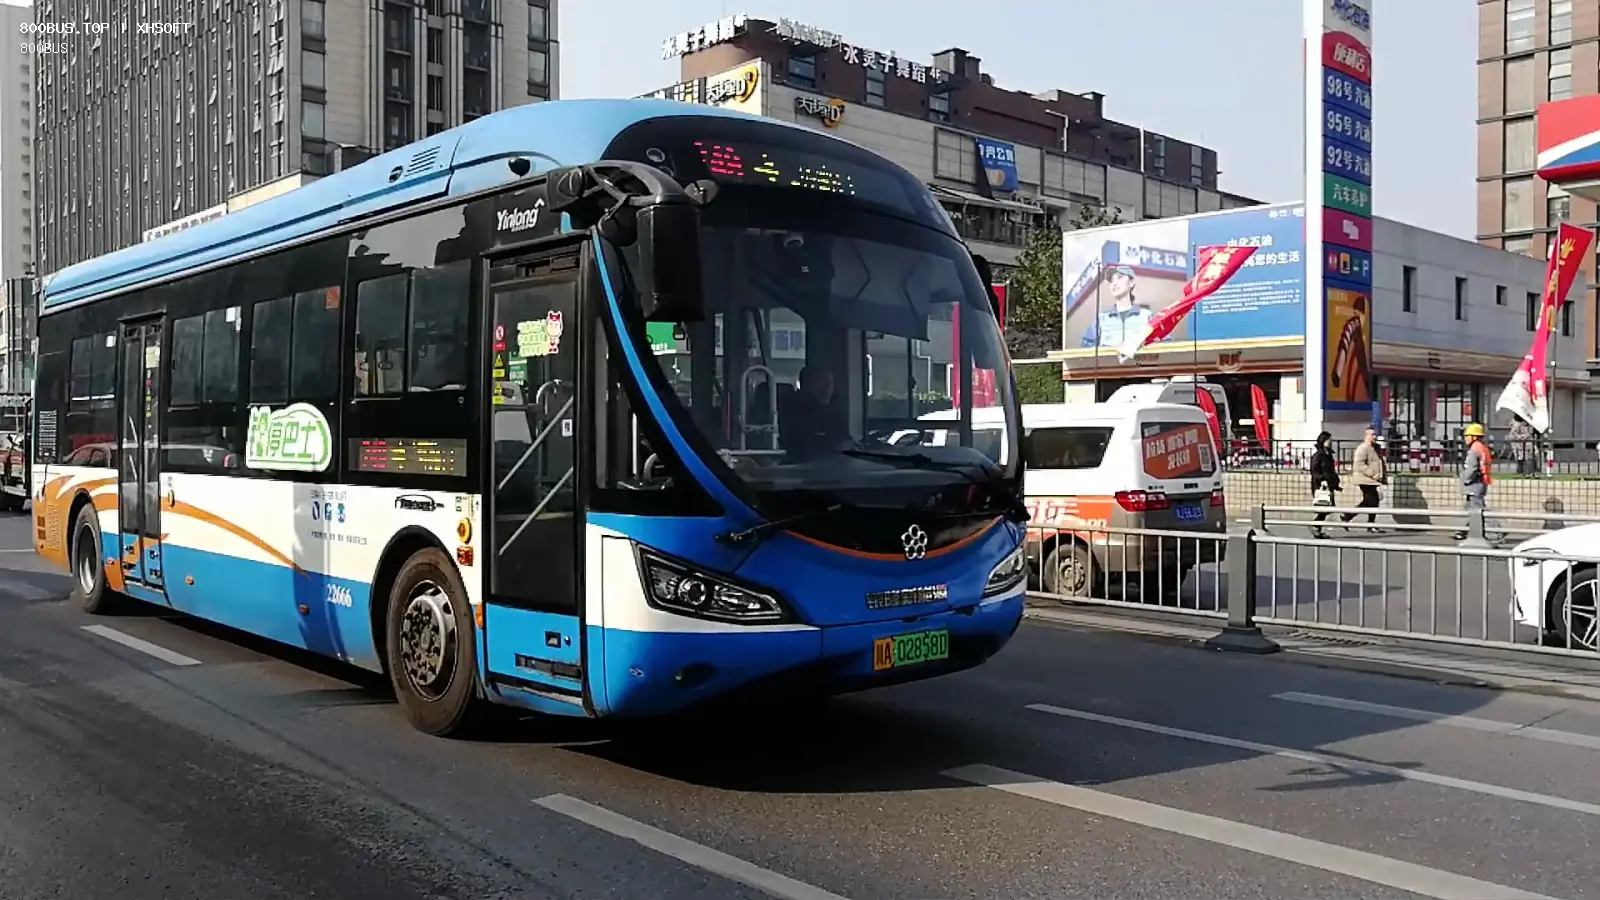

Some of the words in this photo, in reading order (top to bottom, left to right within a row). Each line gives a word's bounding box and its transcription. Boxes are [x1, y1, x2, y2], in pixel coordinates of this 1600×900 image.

[843, 44, 926, 84] 水灵子舞蹈
[1333, 42, 1367, 72] 便利店
[1326, 75, 1352, 101] 98号
[1326, 110, 1352, 136] 95号
[1326, 146, 1352, 171] 92号
[1333, 183, 1368, 207] 汽车养护
[497, 207, 539, 230] Yinlong
[1140, 248, 1187, 267] 中化石油
